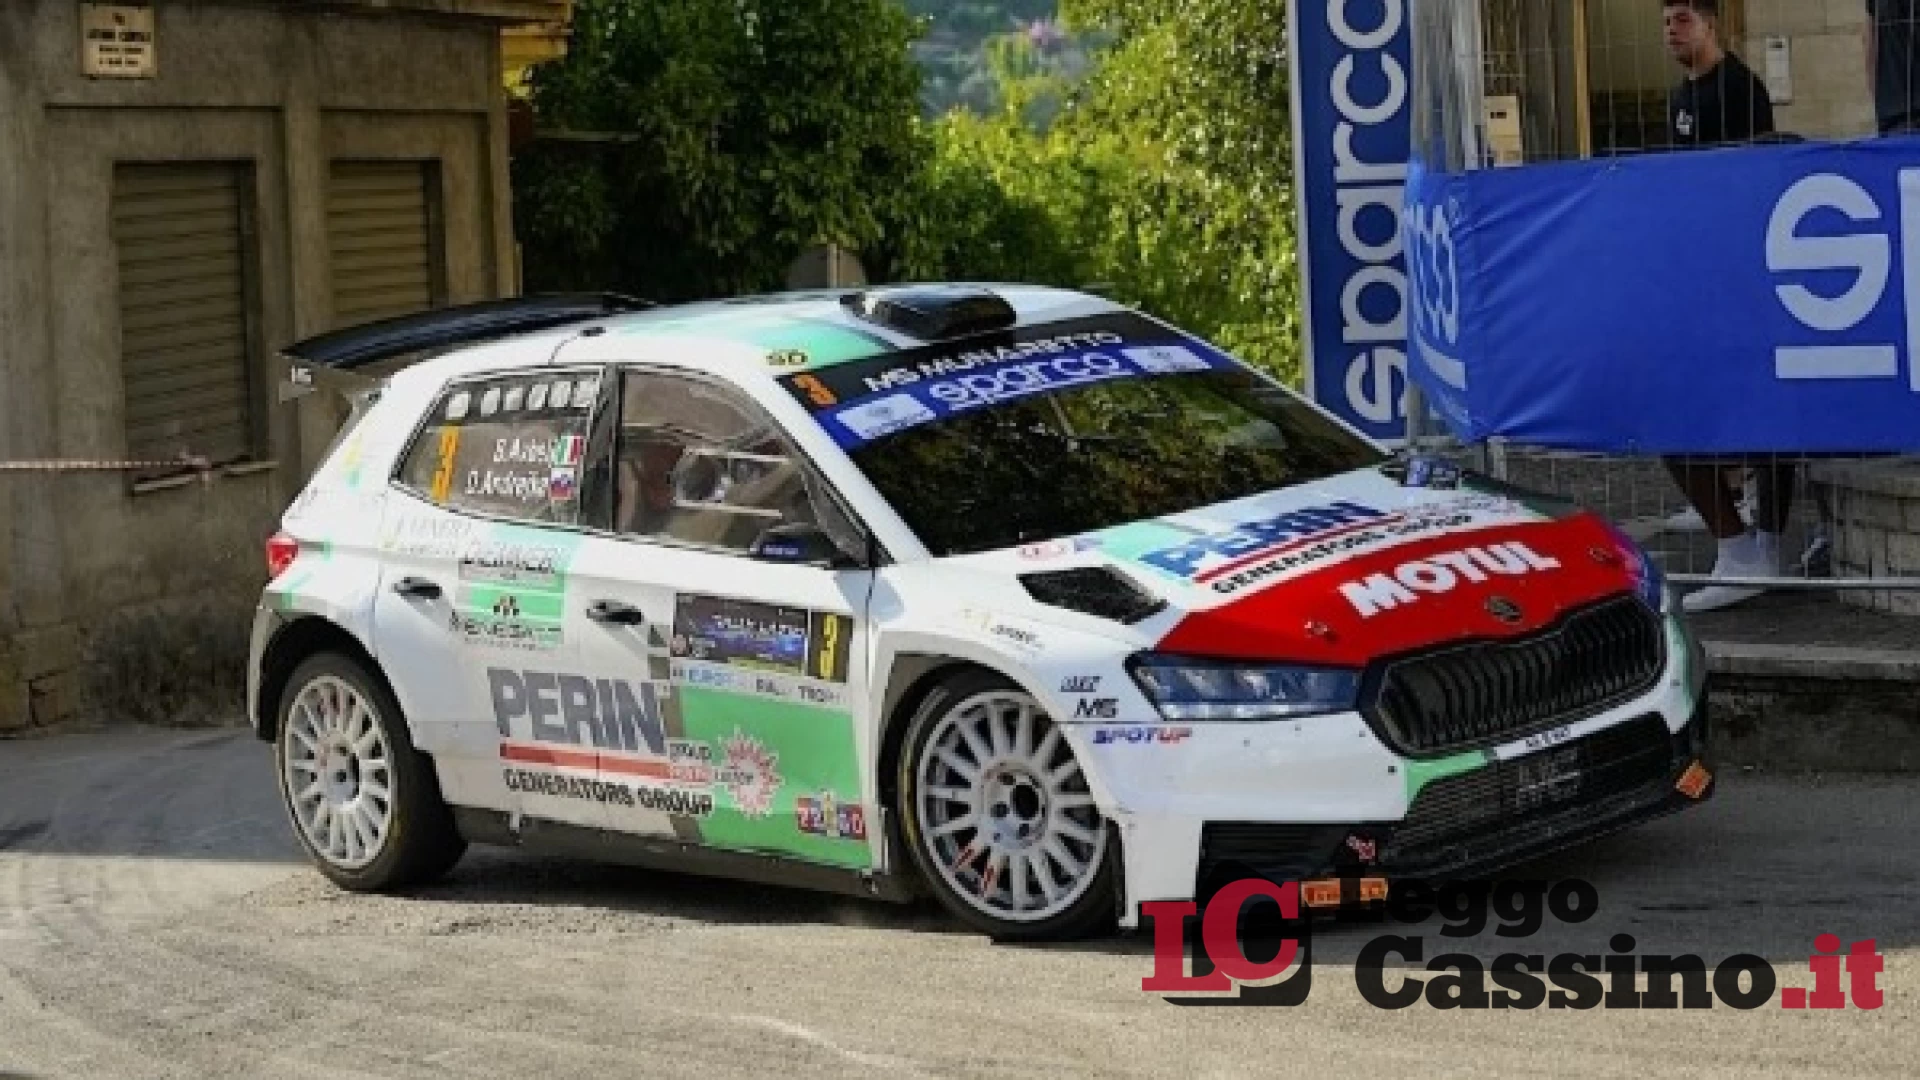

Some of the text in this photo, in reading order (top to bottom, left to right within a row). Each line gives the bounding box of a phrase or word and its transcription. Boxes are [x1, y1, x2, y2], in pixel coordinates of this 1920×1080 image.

[1327, 0, 1407, 423] sparco
[765, 349, 808, 366] SD
[862, 332, 1122, 391] MS MUNARETTO
[929, 353, 1122, 411] sparco
[791, 372, 838, 405] 3
[431, 425, 460, 503] 3
[1138, 502, 1390, 577] PERIN
[1211, 531, 1387, 594] GENERATORS
[1337, 541, 1558, 619] MOTUL
[819, 614, 838, 682] 3
[486, 667, 668, 756] PERIN
[1073, 699, 1119, 718] MS
[1092, 726, 1193, 745] SPOTUP
[503, 768, 636, 809] GENERATORS
[637, 785, 713, 816] GROUP
